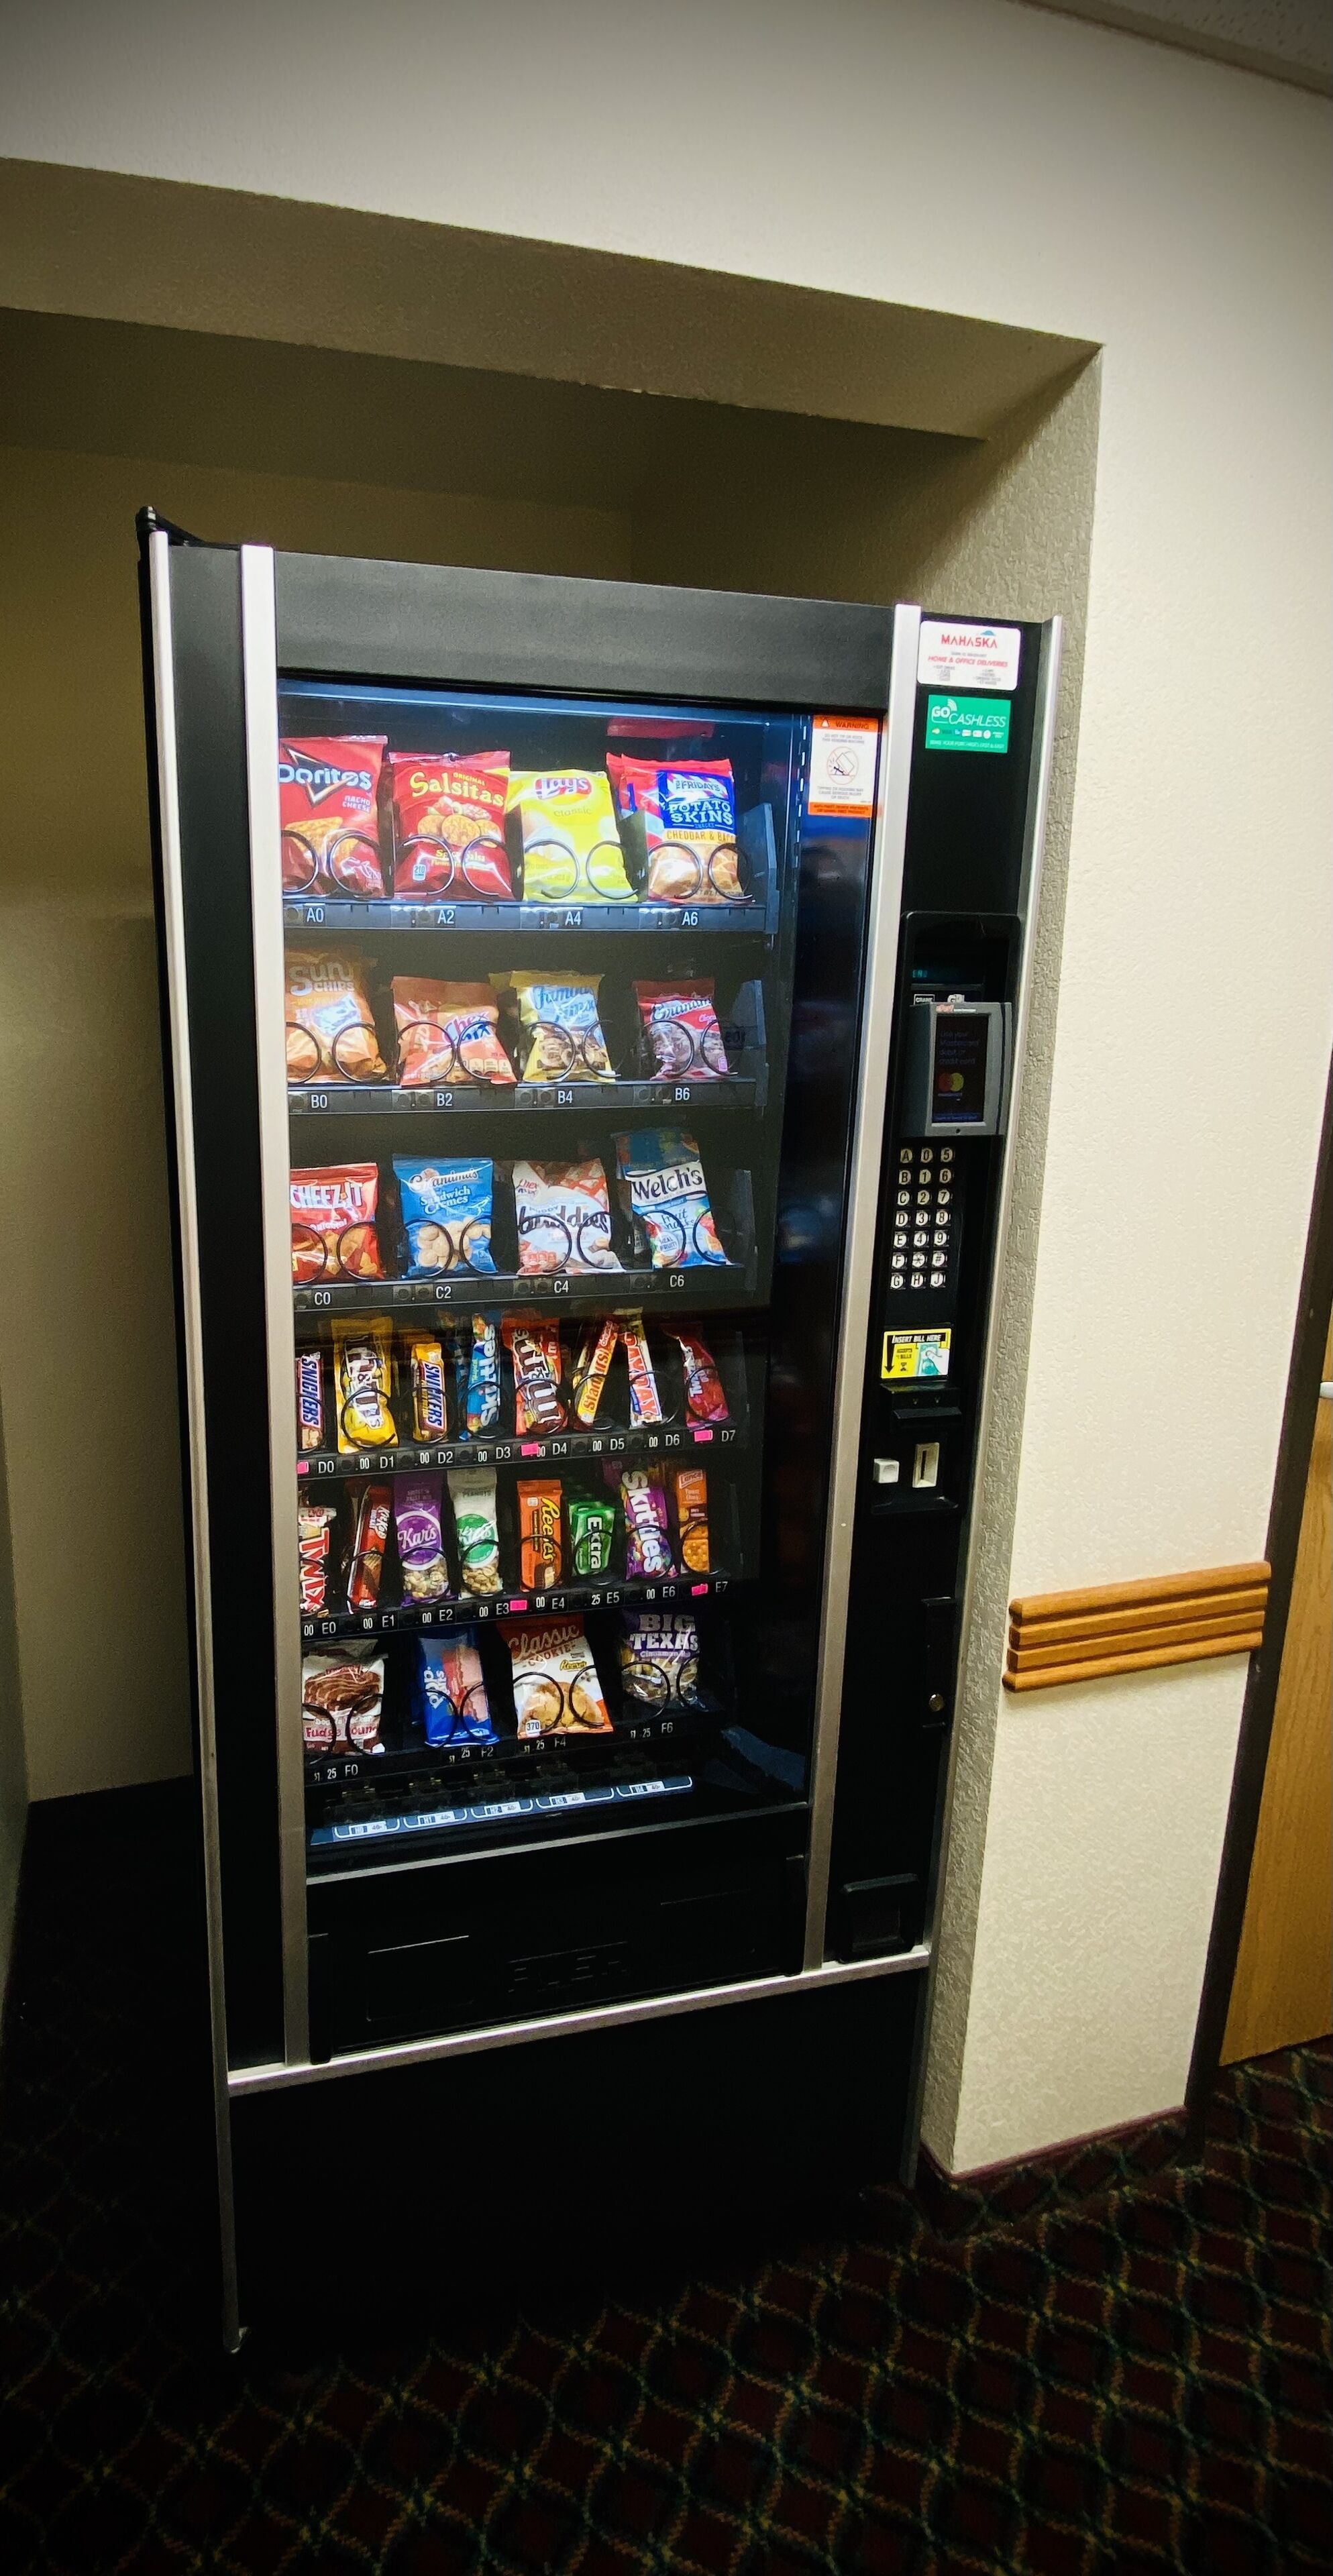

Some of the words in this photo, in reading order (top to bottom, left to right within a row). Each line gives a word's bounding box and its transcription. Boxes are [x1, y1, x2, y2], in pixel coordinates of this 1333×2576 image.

[941, 634, 998, 648] MAHASKA
[932, 706, 951, 718] GO
[949, 713, 1006, 727] CASHLESS
[836, 720, 869, 730] WARNING
[278, 763, 372, 790] Doritos
[454, 772, 486, 787] ORIGINAL
[410, 771, 504, 807] Salsitas
[669, 800, 731, 813] POTATO
[671, 810, 733, 826] SKINS
[667, 830, 705, 841] CHEDDAR
[709, 833, 714, 841] &
[307, 909, 324, 922] A0
[437, 910, 455, 924] A2
[565, 911, 582, 926] A4
[682, 911, 698, 926] A6
[288, 962, 354, 996] Sun
[313, 981, 354, 992] CHIPS
[443, 1011, 489, 1044] Chex
[437, 1093, 453, 1106] B2
[557, 1091, 572, 1104] B4
[675, 1087, 690, 1101] B6
[311, 1095, 327, 1108] B0
[902, 1150, 910, 1161] A
[923, 1150, 929, 1161] 0
[943, 1149, 950, 1160] 5
[410, 1169, 478, 1192] Gandma's
[901, 1172, 908, 1183] B
[922, 1171, 927, 1182] 1
[943, 1170, 949, 1181] 6
[633, 1167, 703, 1201] Welch's
[900, 1193, 906, 1203] C
[920, 1192, 926, 1203] 2
[941, 1191, 947, 1202] 7
[661, 1209, 688, 1224] Frit
[898, 1214, 905, 1224] D
[919, 1213, 924, 1223] 3
[939, 1212, 945, 1222] 8
[897, 1235, 903, 1245] E
[917, 1234, 922, 1244] 4
[937, 1233, 943, 1243] 9
[896, 1256, 902, 1266] F
[554, 1281, 569, 1293] C4
[670, 1275, 684, 1287] C6
[894, 1276, 900, 1286] G
[914, 1275, 920, 1285] H
[934, 1275, 939, 1285] J
[315, 1292, 331, 1305] C0
[436, 1286, 451, 1299] C2
[892, 1335, 912, 1344] INSERT
[302, 1356, 319, 1427] SNICKERS
[423, 1362, 443, 1427] SNICKERS
[665, 1435, 680, 1446] D6
[721, 1430, 735, 1442] D7
[553, 1443, 567, 1455] D4
[610, 1439, 625, 1450] D5
[438, 1452, 453, 1464] D2
[496, 1447, 511, 1459] D3
[319, 1460, 334, 1473] D0
[380, 1456, 394, 1468] D1
[622, 1470, 662, 1573] Skittles
[541, 1497, 561, 1562] Reee's
[397, 1523, 437, 1550] Kar's
[587, 1517, 603, 1570] Extra
[299, 1527, 329, 1610] TWIX
[663, 1587, 676, 1597] E6
[716, 1582, 728, 1593] E7
[552, 1598, 565, 1609] E4
[607, 1592, 619, 1603] E5
[439, 1609, 453, 1621] E2
[496, 1603, 509, 1615] E3
[322, 1621, 336, 1634] E0
[382, 1615, 394, 1627] E1
[639, 1614, 696, 1632] BIG
[509, 1625, 580, 1661] Classic
[629, 1632, 698, 1651] TEXAS
[527, 1721, 539, 1731] 370
[643, 1729, 651, 1737] 25
[661, 1723, 673, 1733] F6
[537, 1739, 545, 1750] 25
[555, 1737, 566, 1747] F4
[462, 1748, 470, 1758] 25
[481, 1747, 493, 1758] F2
[327, 1768, 336, 1779] 25
[345, 1764, 358, 1776] F0
